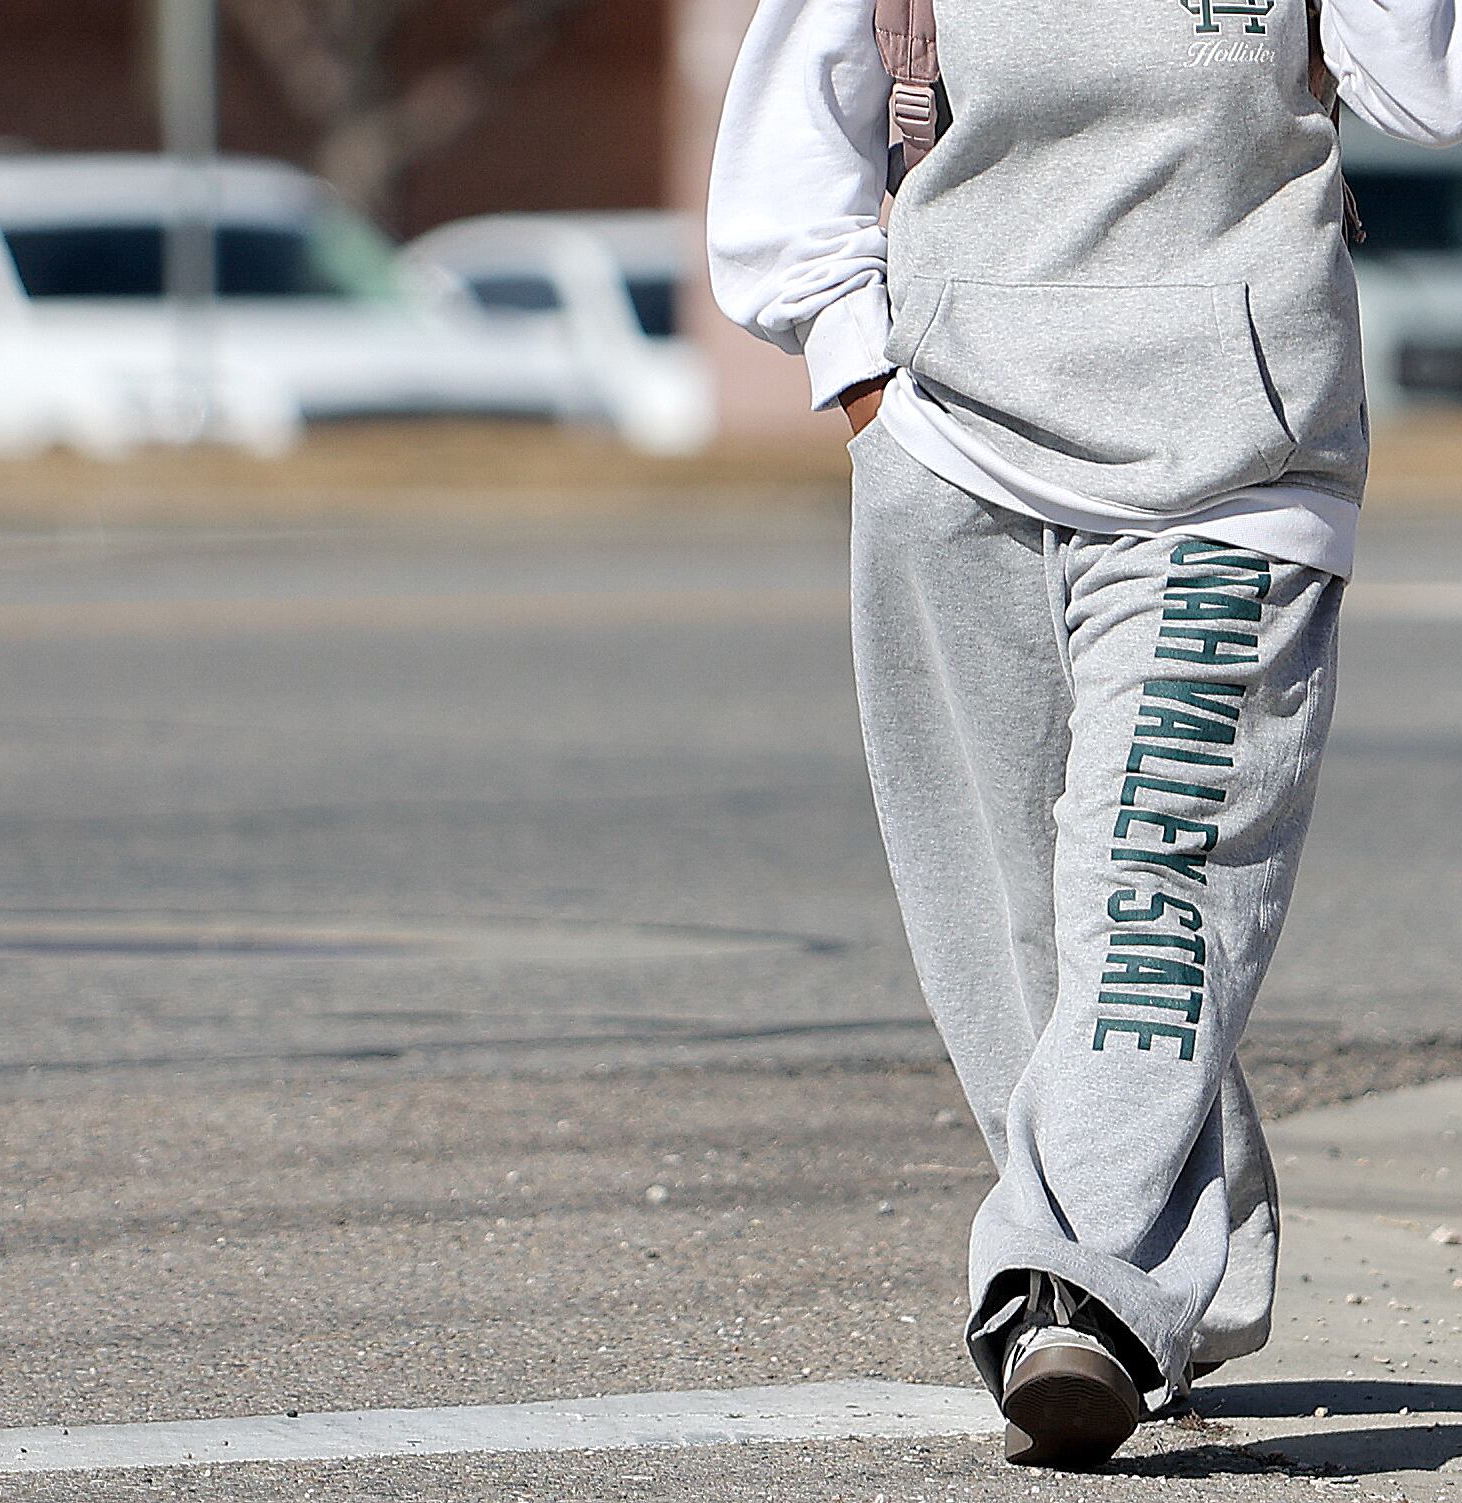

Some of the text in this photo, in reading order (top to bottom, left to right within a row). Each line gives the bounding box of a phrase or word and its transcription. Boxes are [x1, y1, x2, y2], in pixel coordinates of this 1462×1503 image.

[1182, 39, 1276, 68] Hollister
[1111, 680, 1246, 887] VALLEY
[1092, 889, 1207, 1063] STATE
